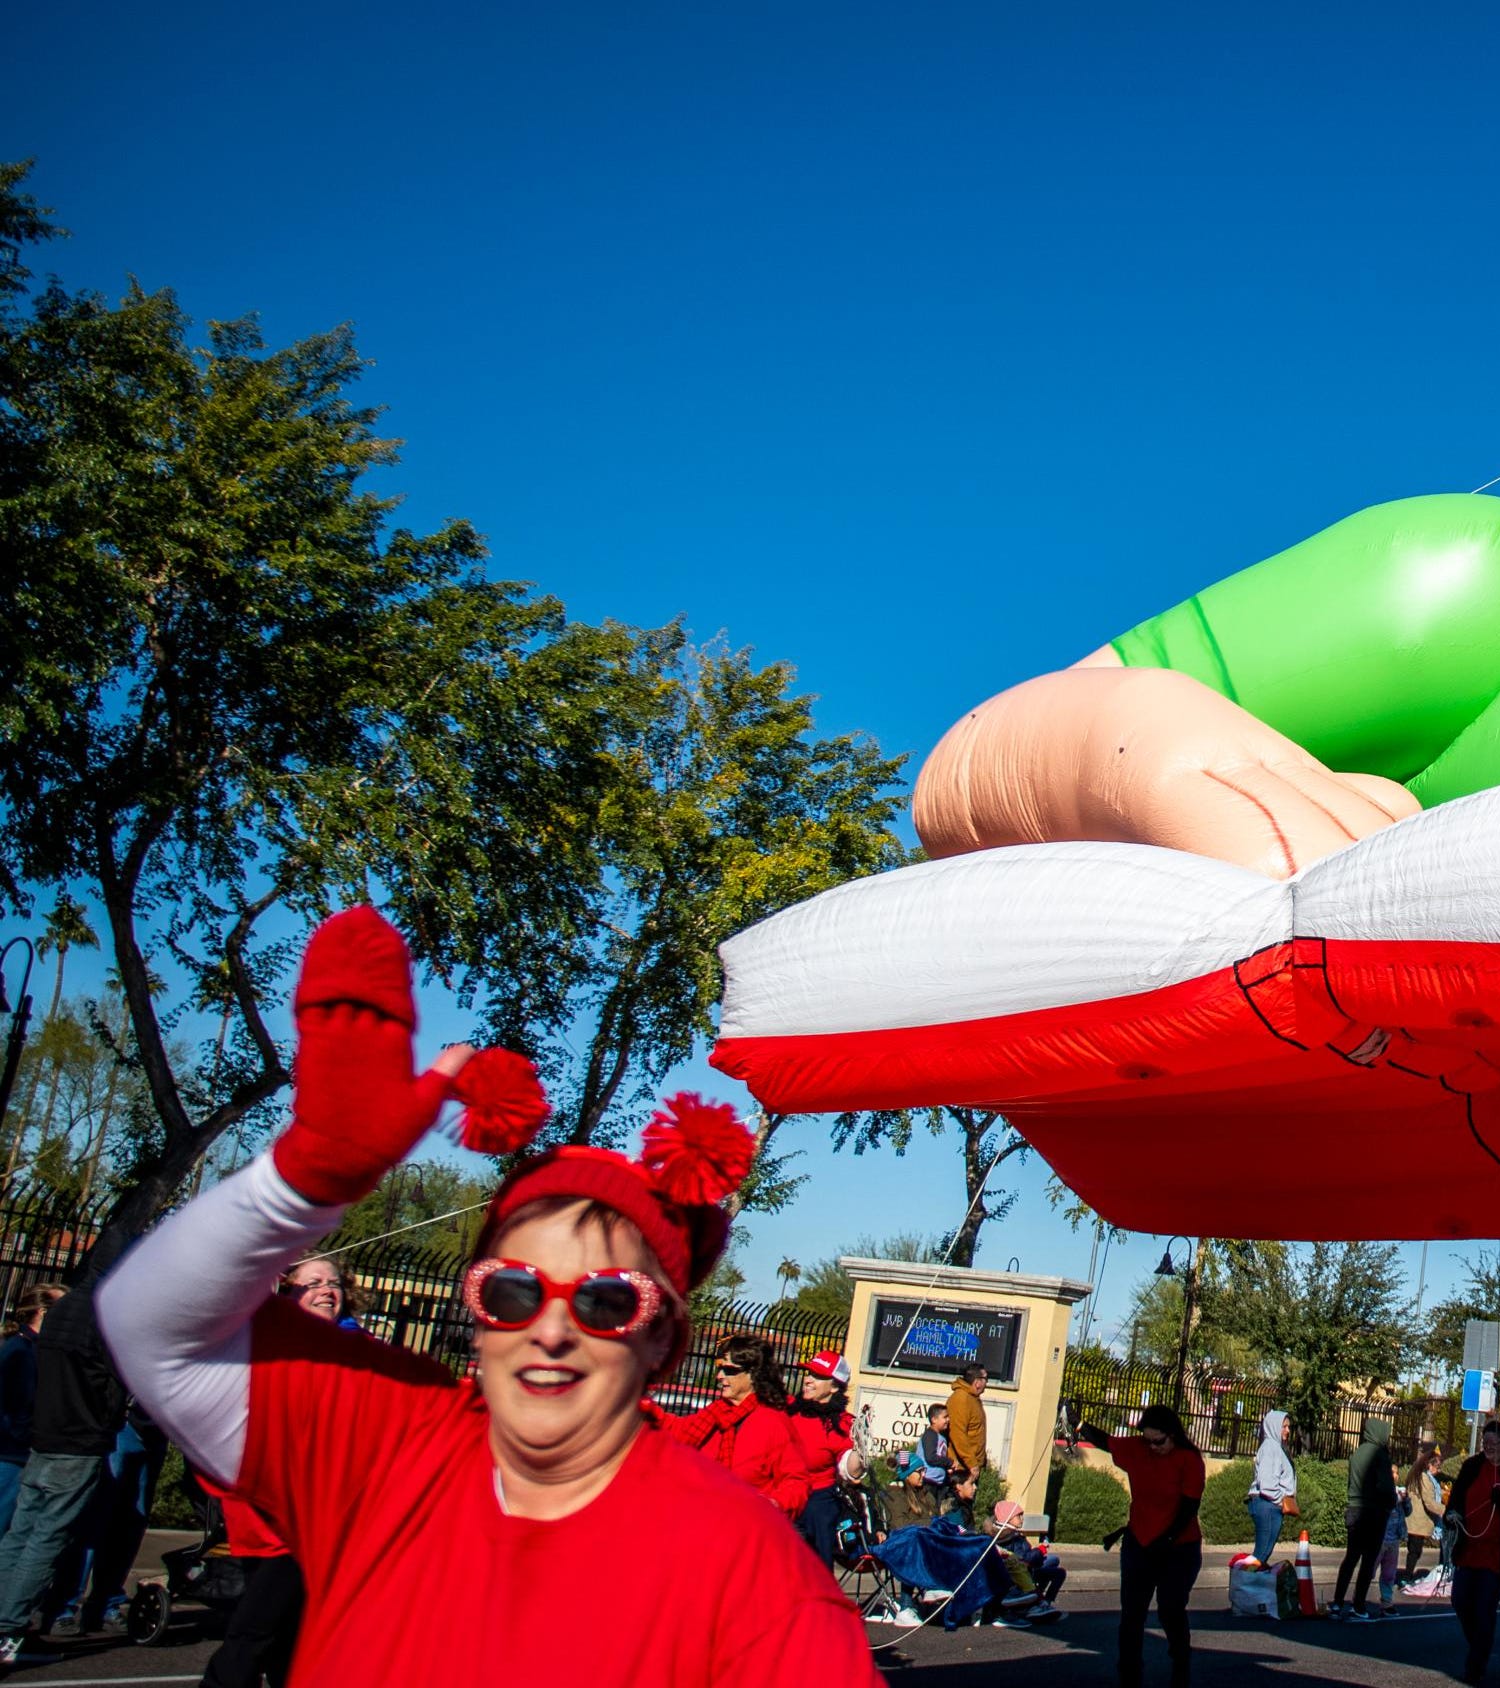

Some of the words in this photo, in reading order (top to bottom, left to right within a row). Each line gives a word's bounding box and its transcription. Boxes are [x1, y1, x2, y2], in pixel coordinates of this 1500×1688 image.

[910, 1317, 948, 1332] SOCCER
[953, 1321, 983, 1336] AWAY
[989, 1325, 1004, 1338] AT
[916, 1330, 967, 1348] HAMILTON
[902, 1342, 947, 1358] JANUARY
[956, 1347, 978, 1361] 7TH
